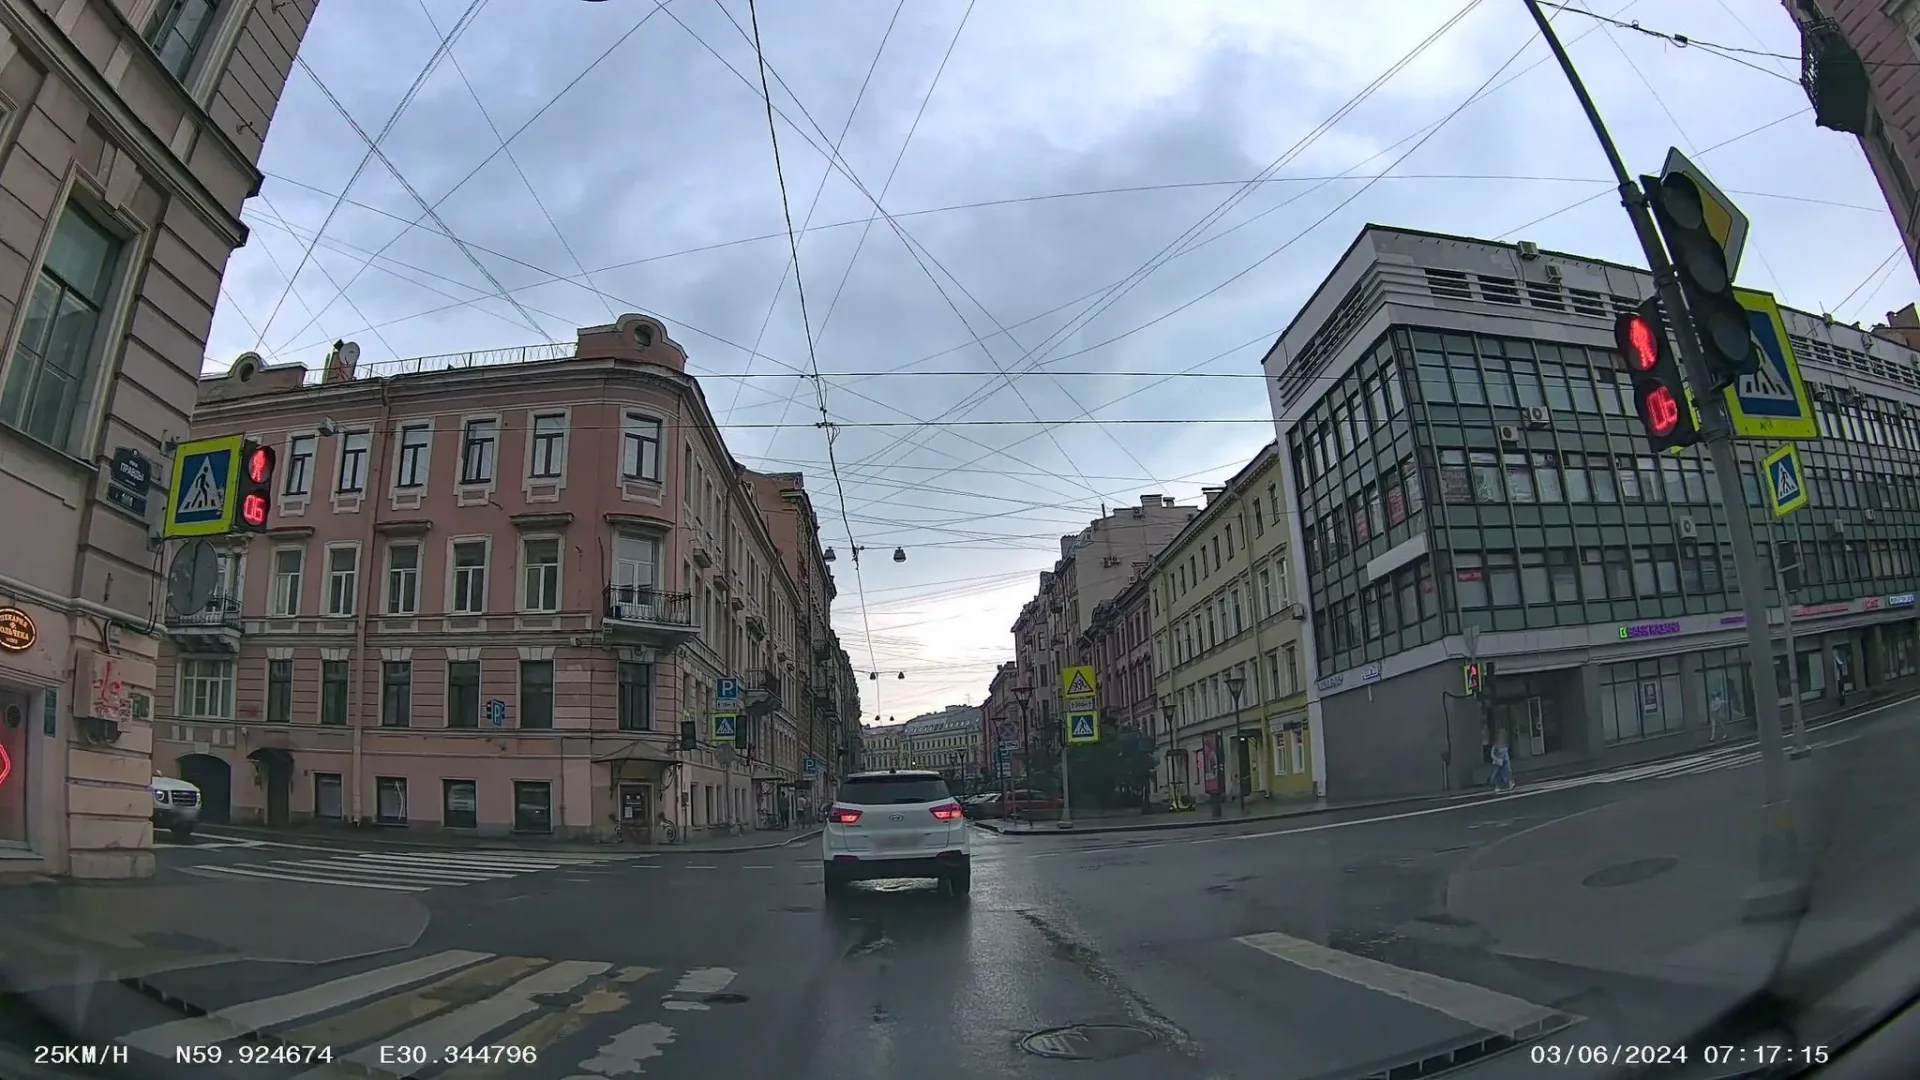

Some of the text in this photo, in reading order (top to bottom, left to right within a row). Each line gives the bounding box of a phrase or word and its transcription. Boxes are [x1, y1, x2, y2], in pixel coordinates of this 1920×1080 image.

[120, 462, 145, 482] ПРАВДЫ
[243, 494, 264, 523] 06
[0, 626, 29, 640] ОЛЬЧЕКА
[722, 680, 733, 696] P
[806, 759, 814, 771] P
